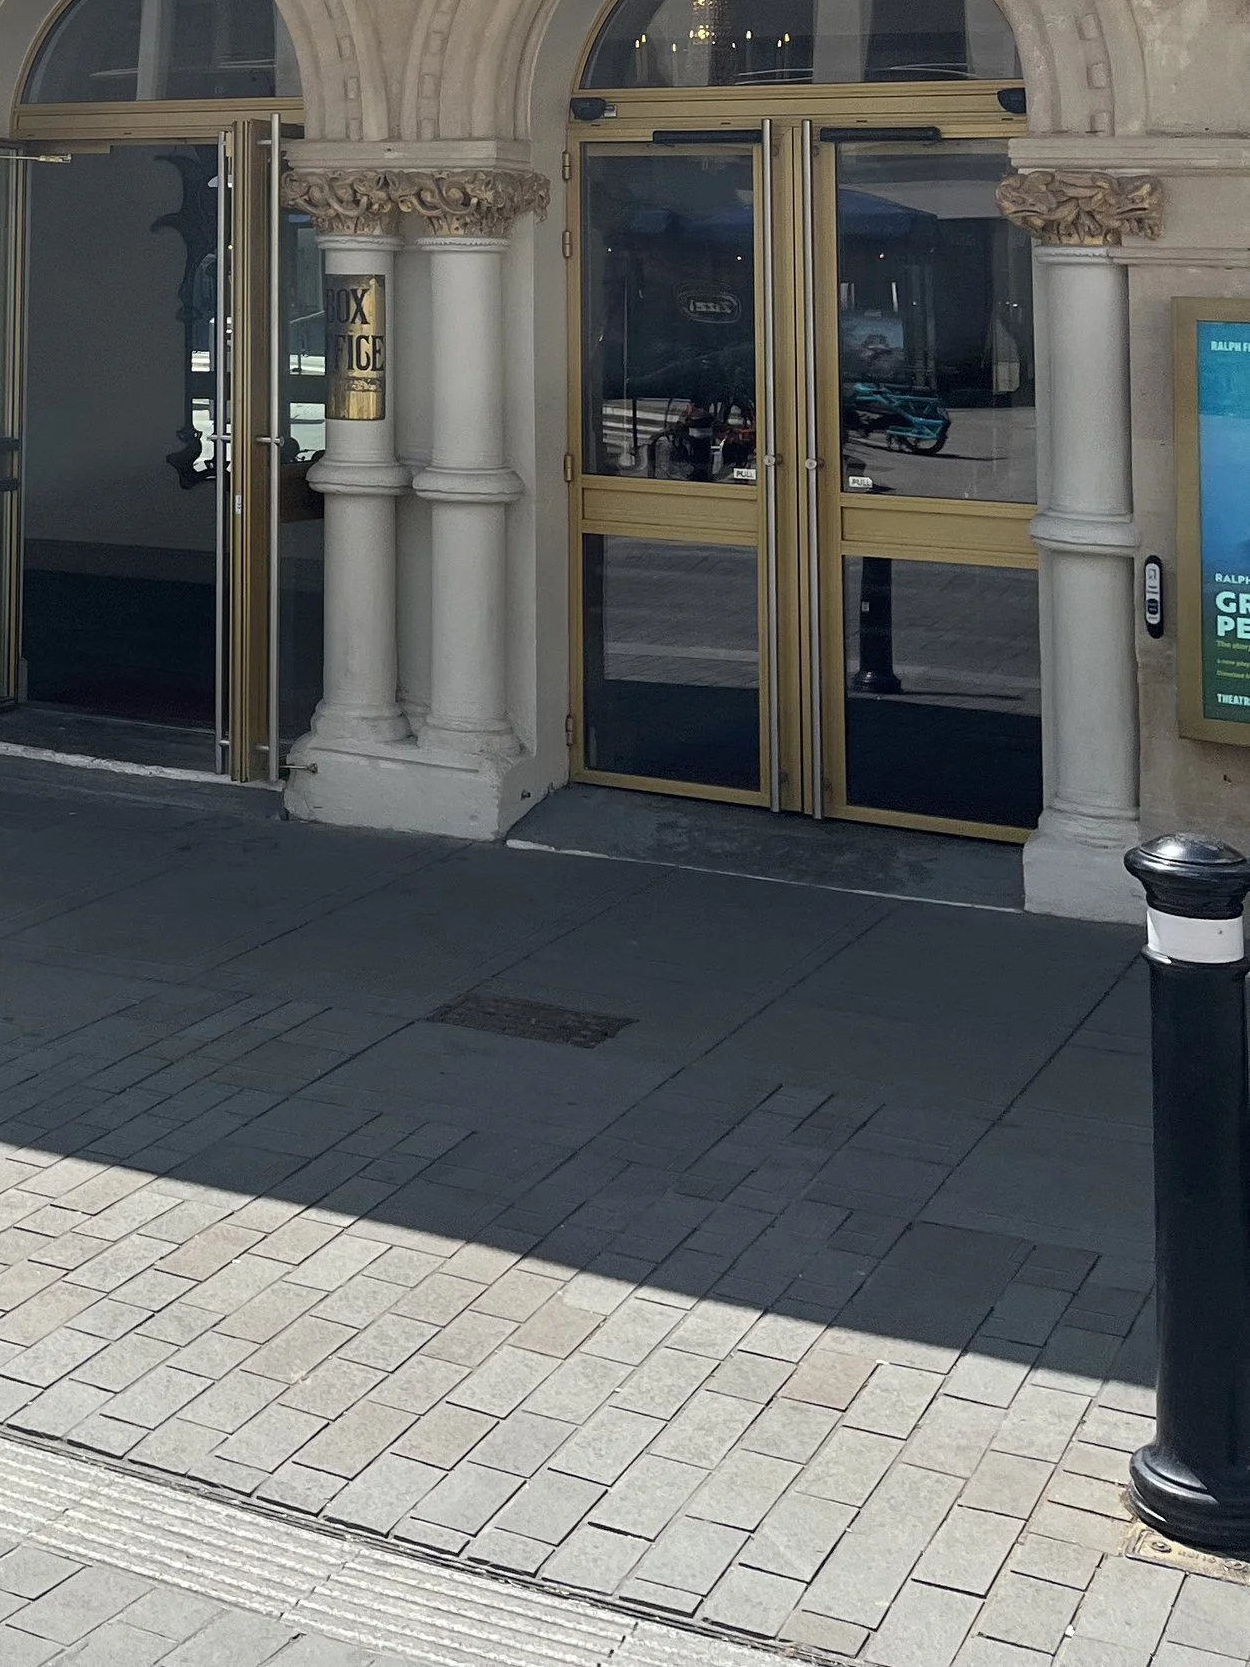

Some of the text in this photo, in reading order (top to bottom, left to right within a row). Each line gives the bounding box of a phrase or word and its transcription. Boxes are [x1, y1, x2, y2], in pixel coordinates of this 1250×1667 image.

[325, 287, 371, 325] BOX
[333, 334, 386, 372] FICE
[1210, 340, 1242, 352] RALPH
[851, 478, 871, 487] PULL
[1216, 615, 1250, 640] PE
